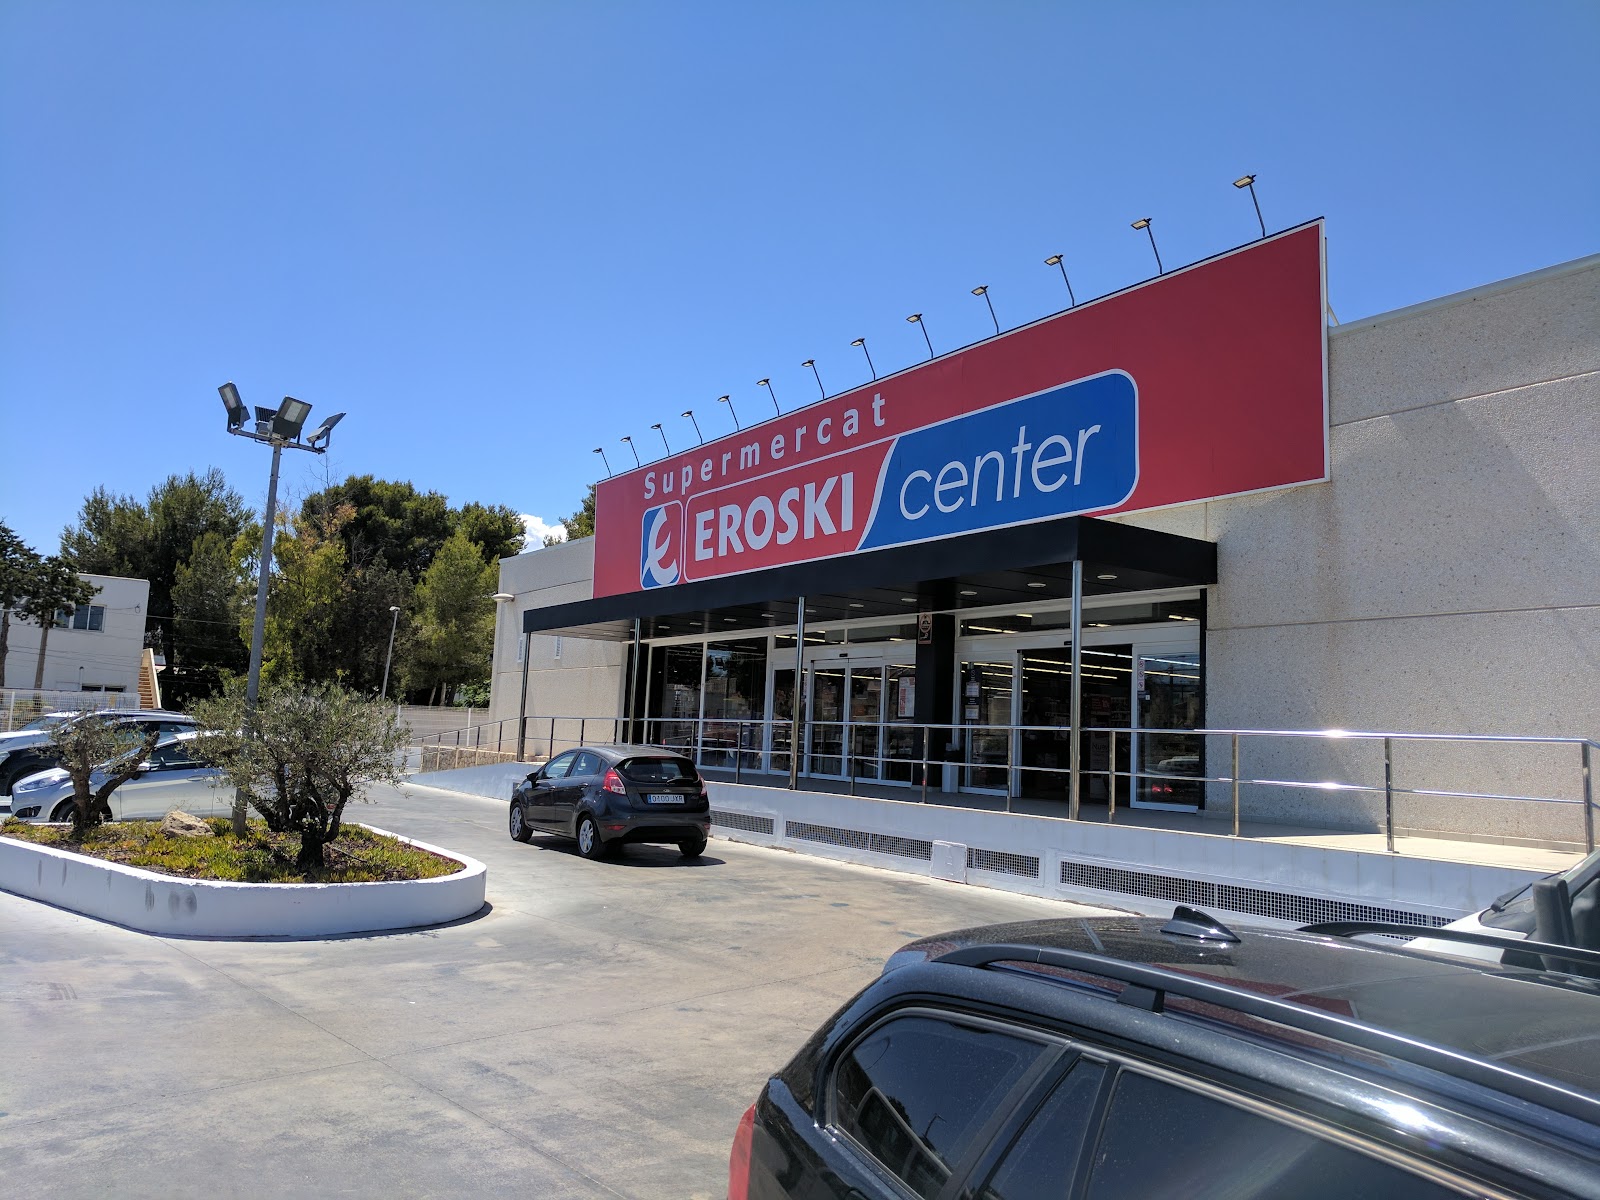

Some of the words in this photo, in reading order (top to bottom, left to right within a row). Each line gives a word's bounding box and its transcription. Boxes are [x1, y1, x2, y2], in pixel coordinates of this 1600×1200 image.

[644, 392, 886, 500] Supermercat
[694, 471, 855, 562] EROSKI
[899, 424, 1102, 521] center
